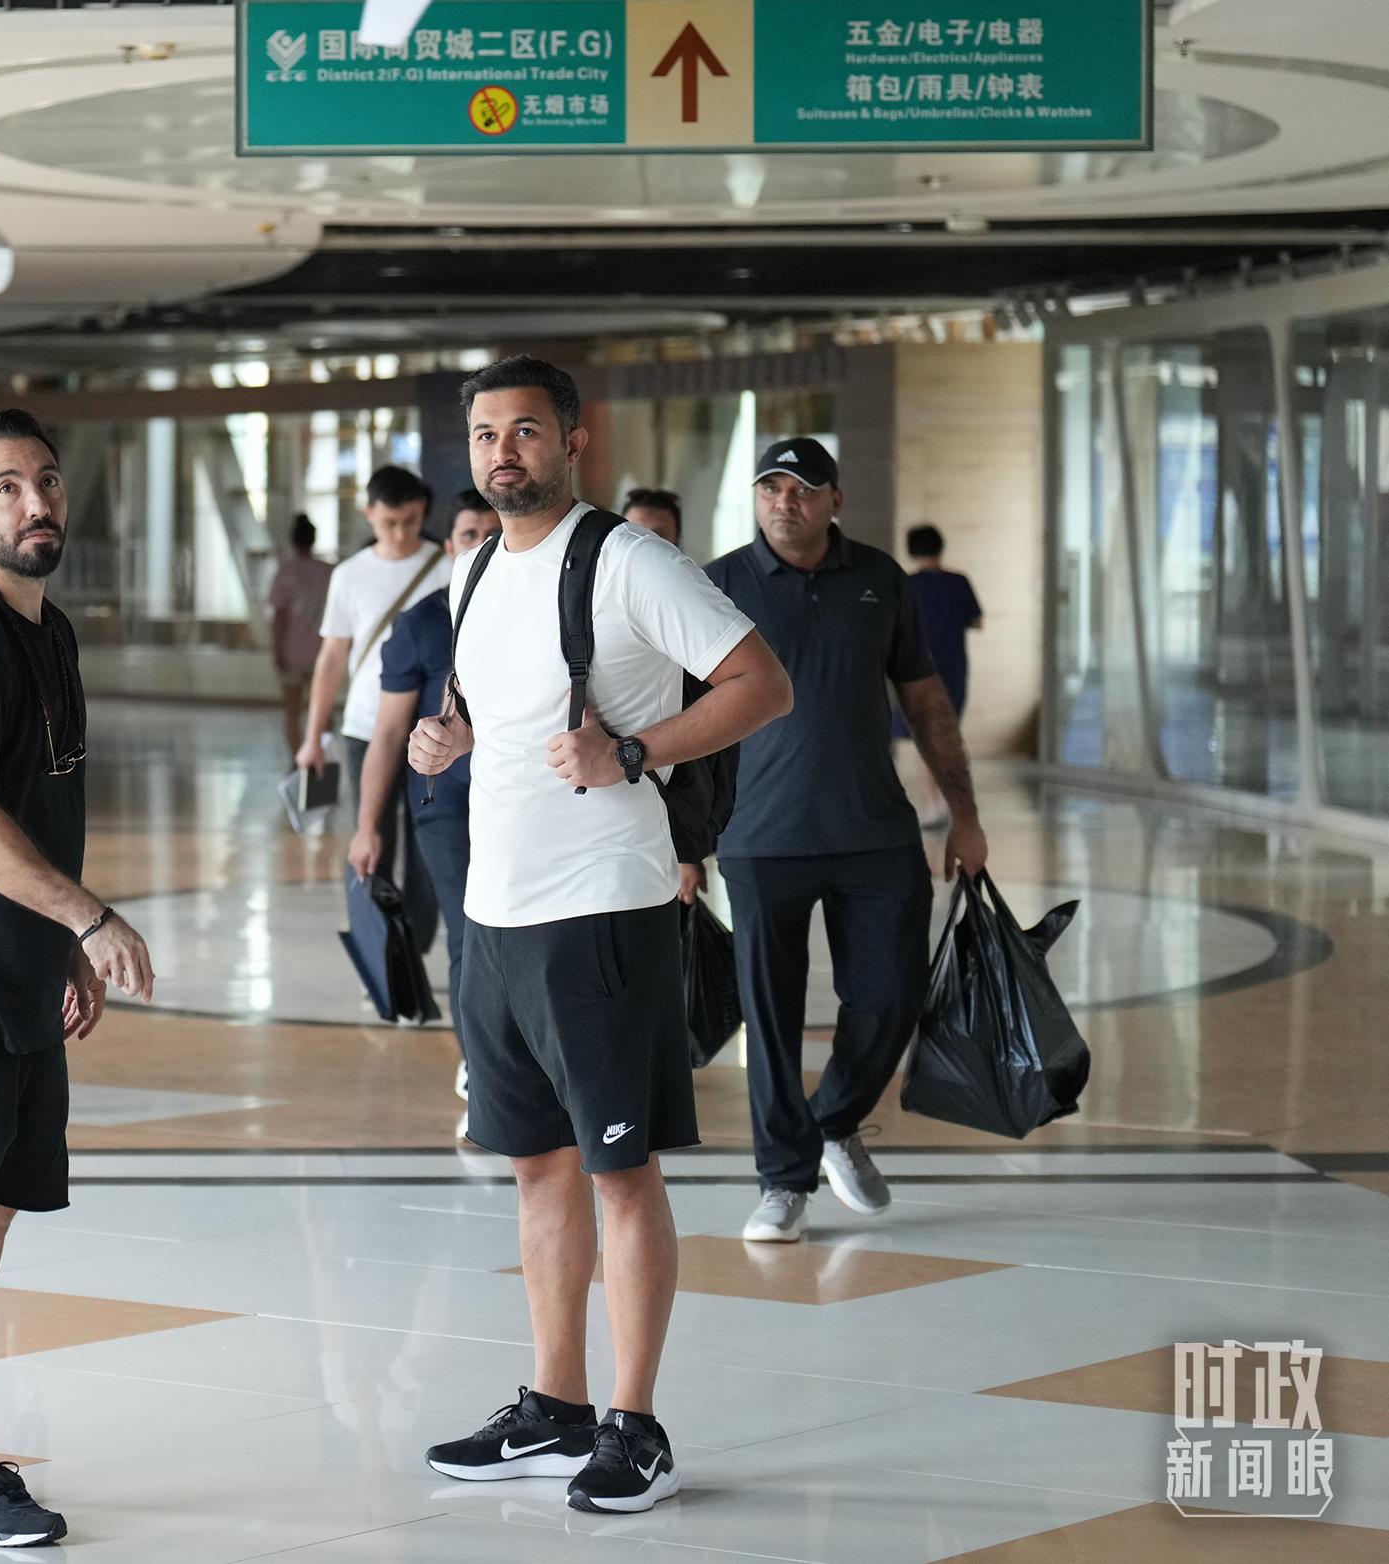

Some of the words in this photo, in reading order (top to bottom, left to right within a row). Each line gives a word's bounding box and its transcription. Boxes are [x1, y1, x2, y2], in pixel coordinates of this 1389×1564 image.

[846, 18, 1044, 46] 五金/电子/电器
[317, 68, 373, 81] District
[427, 68, 527, 80] International
[530, 67, 574, 80] Trade
[577, 67, 609, 82] City
[846, 73, 1044, 102] 箱包/雨具/钟表
[523, 95, 610, 115] 无烟市场
[797, 107, 858, 119] Suitcases
[860, 107, 871, 119] &
[1024, 106, 1035, 118] &
[1037, 106, 1092, 118] Watches
[607, 1122, 626, 1136] NIKE
